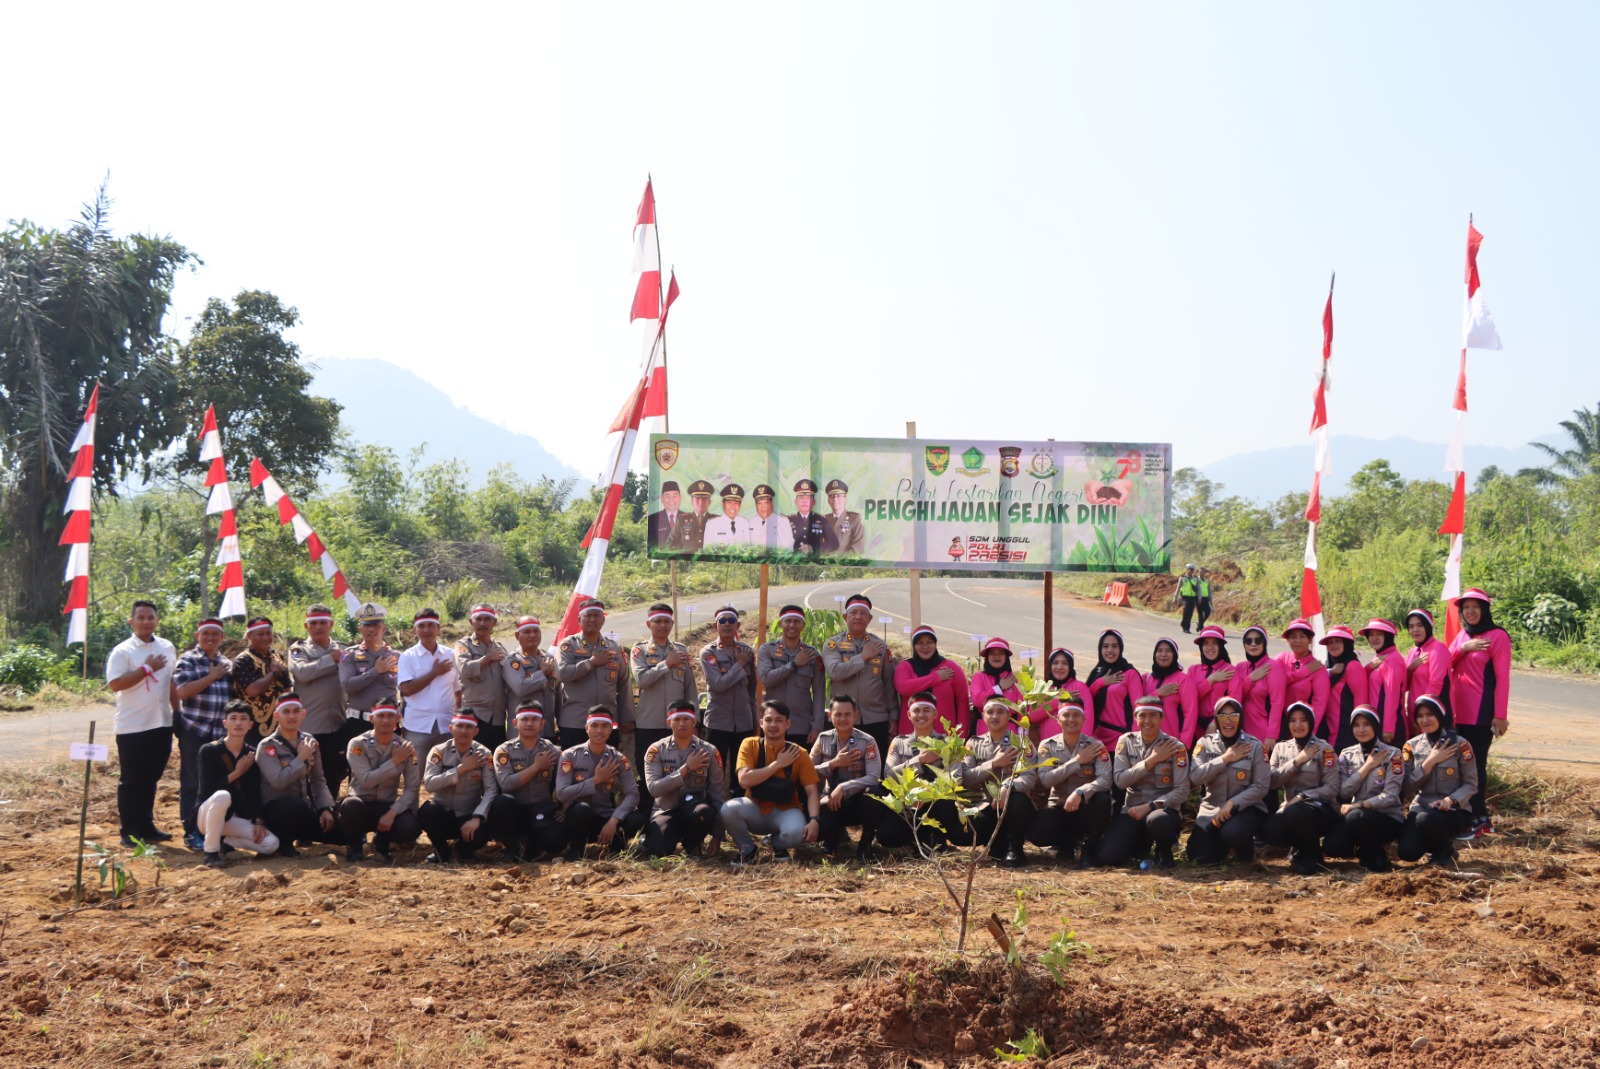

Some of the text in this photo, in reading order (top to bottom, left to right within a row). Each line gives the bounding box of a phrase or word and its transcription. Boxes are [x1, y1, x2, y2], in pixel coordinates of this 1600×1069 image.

[896, 477, 1084, 506] Polri Lestarikan Negeri
[864, 499, 1118, 525] PENGHIJAUAN SEJAK DINI
[968, 535, 1031, 544] SDM UNGGUL
[968, 543, 1007, 551] POLRI
[968, 550, 1028, 560] PRESISI
